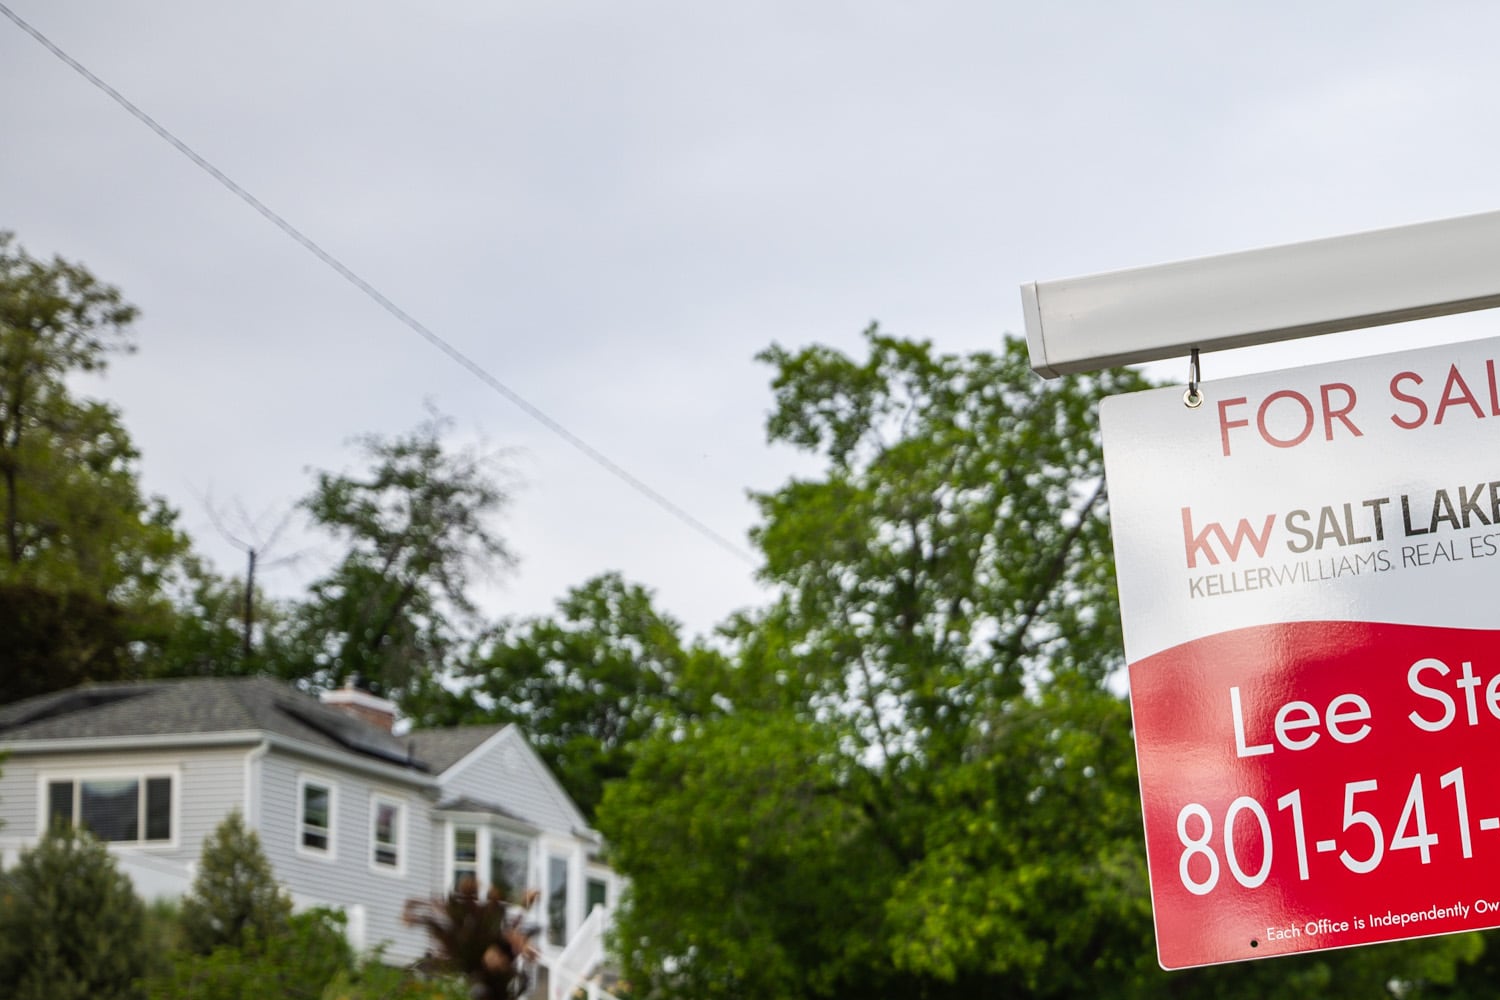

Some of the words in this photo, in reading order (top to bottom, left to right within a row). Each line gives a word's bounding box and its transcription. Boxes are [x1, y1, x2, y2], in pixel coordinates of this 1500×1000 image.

[1216, 381, 1364, 457] FOR
[1180, 506, 1277, 568] kw
[1284, 497, 1390, 554] SALT
[1401, 539, 1464, 569] REAL
[1229, 685, 1373, 758] Lee
[1266, 923, 1301, 941] Each
[1304, 918, 1350, 936] Office
[1353, 915, 1366, 930] is
[1369, 900, 1470, 928] Independently
